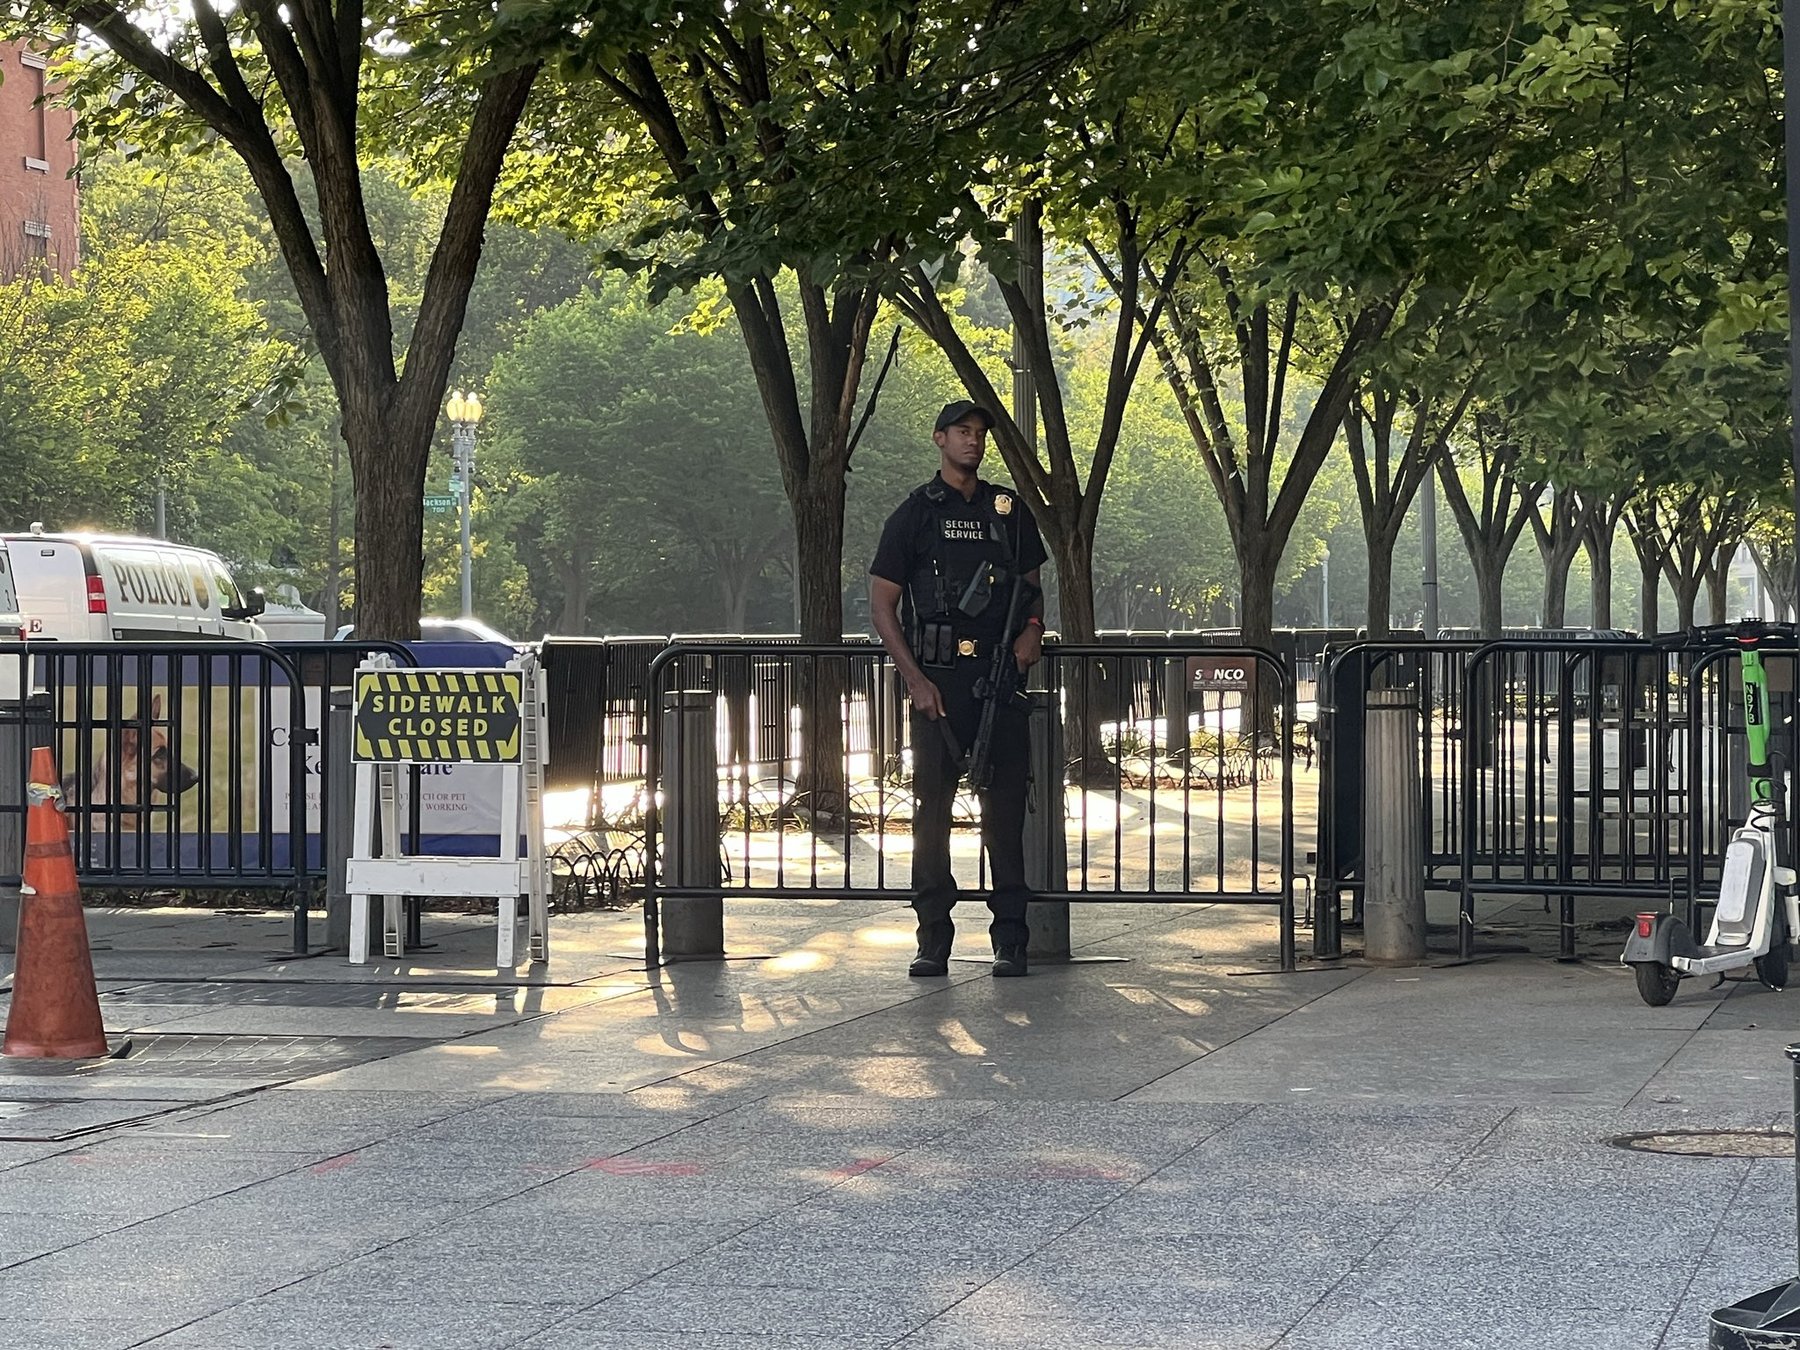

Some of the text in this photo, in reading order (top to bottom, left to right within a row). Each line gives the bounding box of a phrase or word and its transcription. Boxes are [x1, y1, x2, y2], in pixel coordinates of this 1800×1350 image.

[945, 520, 981, 529] SECRET
[944, 530, 984, 540] SERVICE
[112, 563, 191, 607] POLICE
[372, 695, 506, 714] SIDEWALK
[388, 718, 489, 736] CLOSED
[436, 793, 449, 801] OR
[425, 803, 468, 811] WORKING
